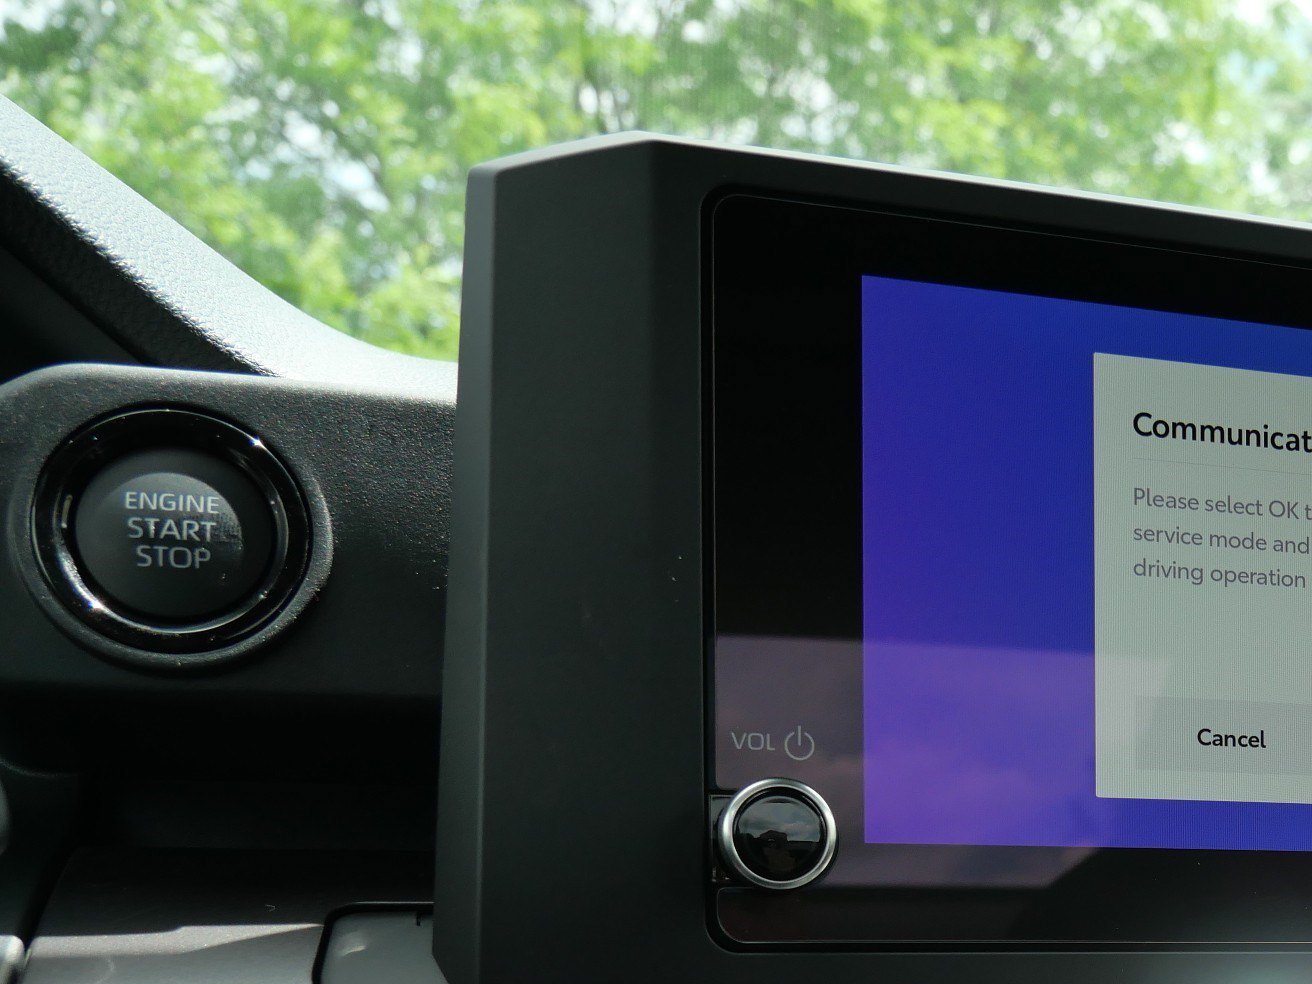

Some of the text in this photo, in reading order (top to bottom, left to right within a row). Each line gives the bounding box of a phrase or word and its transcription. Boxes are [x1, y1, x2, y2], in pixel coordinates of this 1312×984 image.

[124, 490, 220, 515] ENGINE
[1133, 486, 1200, 511] Please
[1204, 494, 1264, 517] select
[1268, 500, 1300, 520] OK
[127, 516, 217, 544] START
[1133, 526, 1204, 546] service
[1208, 531, 1268, 552] mode
[1272, 536, 1310, 555] and
[136, 544, 212, 570] STOP
[1133, 557, 1307, 589] driving operation
[731, 731, 775, 752] VOL
[1196, 727, 1268, 750] Cancel
